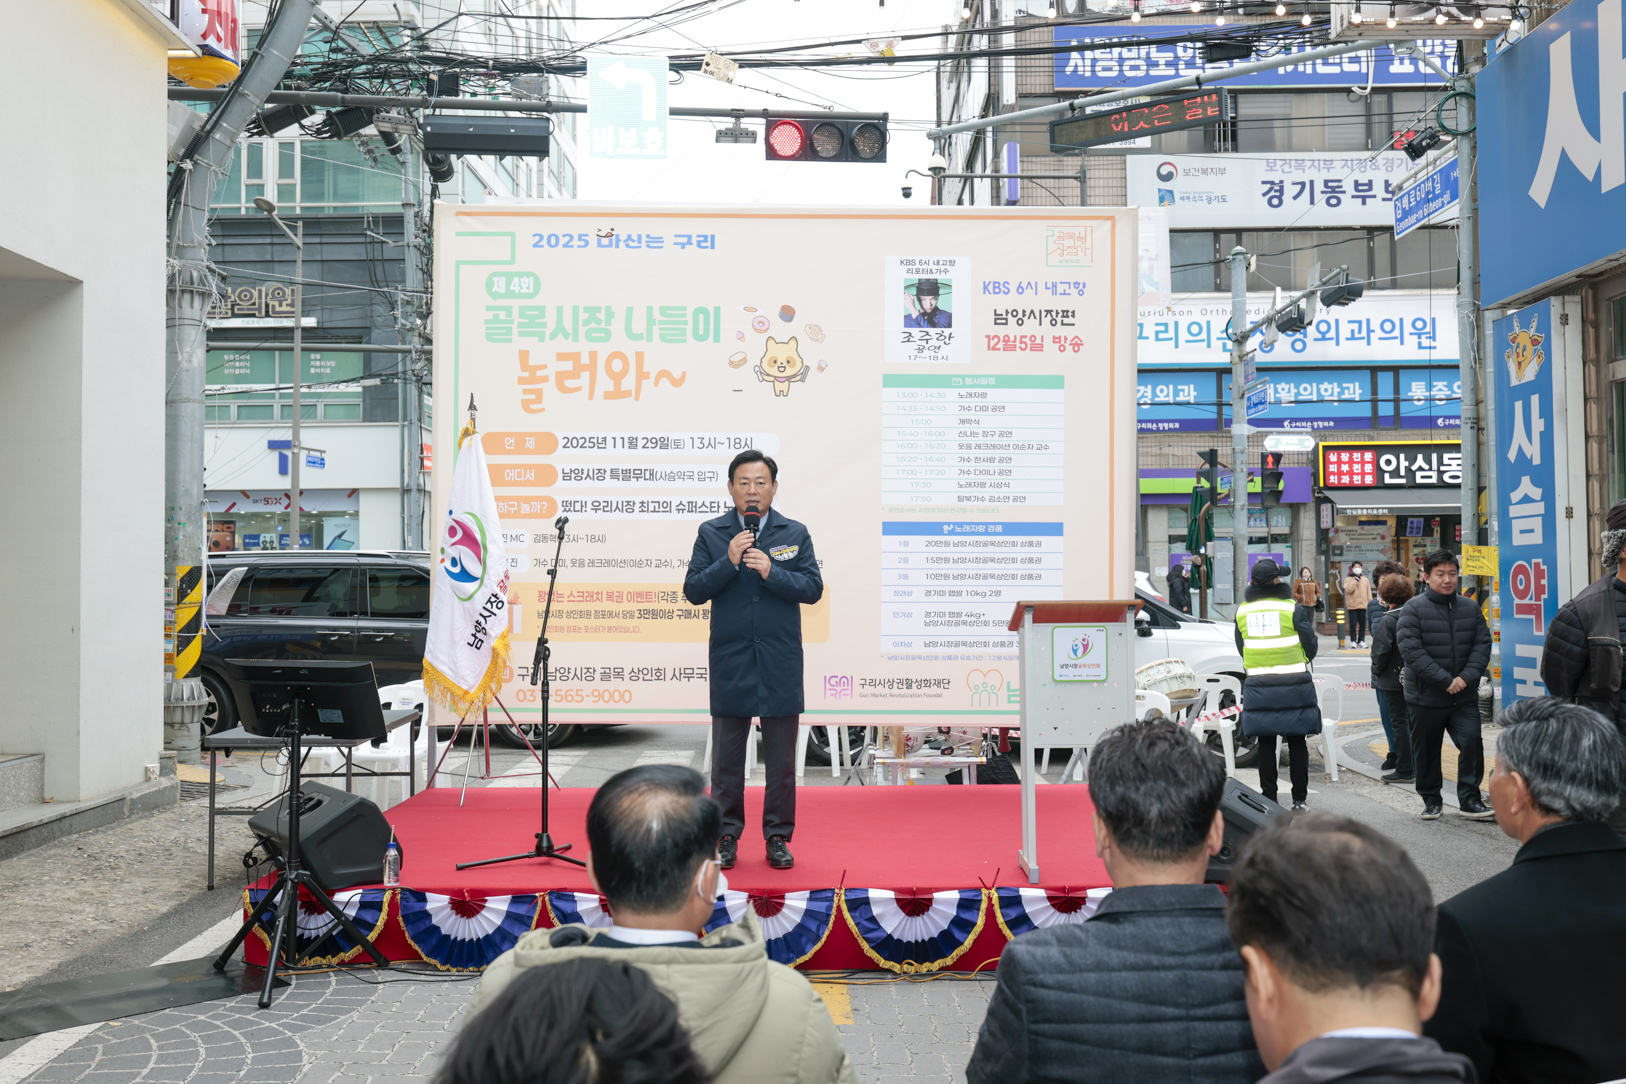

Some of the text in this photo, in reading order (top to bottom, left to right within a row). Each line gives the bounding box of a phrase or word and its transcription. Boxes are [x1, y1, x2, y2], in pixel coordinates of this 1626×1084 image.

[593, 125, 666, 156] 비보호
[1264, 157, 1337, 173] 보건복지부
[1183, 167, 1227, 177] 보건복지부
[1395, 172, 1442, 219] 검배로60번길
[531, 233, 590, 249] 2025
[673, 234, 716, 250] 구리
[900, 259, 956, 267] KBS 6시 내고향
[906, 267, 950, 276] 리포터&가수
[491, 277, 535, 294] 제 4회
[983, 281, 1087, 296] KBS 6시 내고향
[993, 309, 1076, 327] 남양시장편
[484, 305, 721, 344] 골목시장 나들이
[985, 334, 1084, 353] 12월5일 방송
[908, 354, 949, 362] 17~18시
[517, 349, 687, 414] 놀러와~
[964, 377, 996, 386] 행사일정
[958, 392, 988, 400] 노래자랑
[958, 405, 1005, 413] 가수 다미 공연
[504, 437, 535, 449] 언 제
[562, 436, 754, 450] 2025년 11월 29일(토) 13시~18시
[974, 443, 1010, 451] 레크레이션
[1035, 443, 1050, 451] 교수
[957, 456, 972, 464] 가수
[997, 456, 1012, 464] 공연
[1328, 452, 1373, 462] 심장전문
[1328, 463, 1373, 473] 피부전문
[504, 469, 535, 482] 어디서
[562, 468, 607, 482] 남양시장
[697, 469, 719, 482] 입구)
[1328, 474, 1374, 485] 치과전문
[1011, 495, 1026, 503] 공연
[520, 501, 548, 514] 놀까?
[562, 501, 721, 514] 떴다! 우리시장 최고의 슈퍼스타
[954, 525, 986, 533] 노래자랑
[510, 534, 525, 543] MC
[925, 540, 950, 548] 20만원
[952, 540, 1018, 548] 남양시장골목상인회
[1020, 540, 1042, 548] 상품권
[1507, 394, 1548, 696] 사슴약국
[533, 558, 548, 568] 가수
[569, 558, 585, 568] 웃음
[926, 573, 950, 581] 10만원
[952, 573, 1018, 581] 남양시장골목상인회
[1020, 573, 1042, 581] 상품권
[567, 590, 604, 603] 스크래치
[605, 590, 624, 603] 복권
[566, 608, 591, 620] 상인회원
[593, 608, 620, 620] 점포에서
[621, 608, 635, 620] 당일
[636, 608, 674, 620] 3만원이상
[676, 608, 700, 620] 구매시
[924, 619, 990, 627] 남양시장골목상인회
[600, 666, 625, 682] 골목
[629, 666, 667, 682] 상인회
[859, 677, 951, 690] 구리시상권활성화재단
